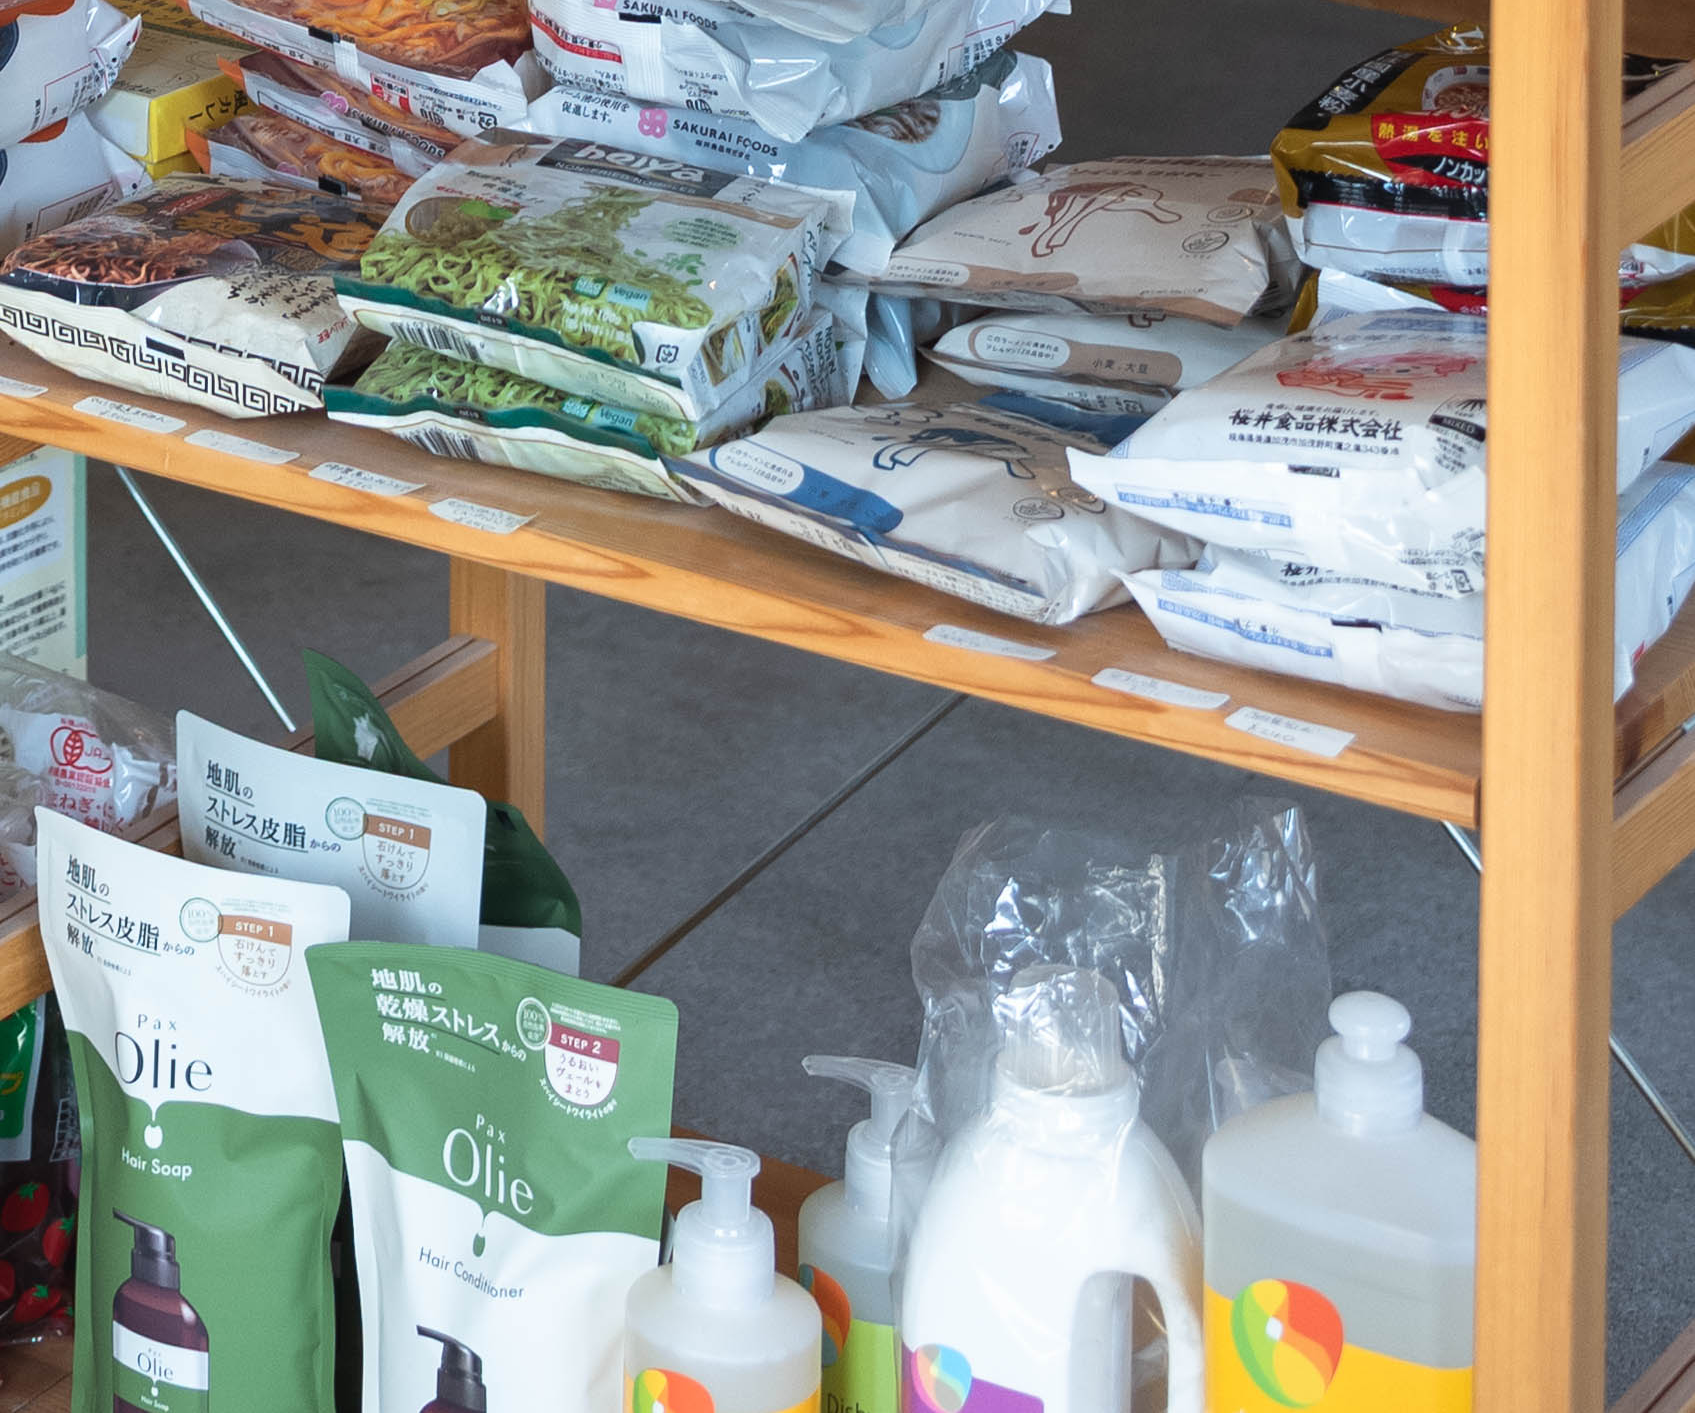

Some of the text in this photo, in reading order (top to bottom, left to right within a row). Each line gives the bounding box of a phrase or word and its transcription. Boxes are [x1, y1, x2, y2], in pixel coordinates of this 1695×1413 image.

[623, 0, 719, 31] SAKURAI FOODS
[561, 100, 613, 124] 促進します。
[672, 118, 779, 158] SAKURAI FOODS
[1432, 156, 1490, 185] ノンカッ
[612, 285, 650, 303] Vegan
[599, 407, 634, 428] Vegan
[1228, 407, 1404, 442] 桜井食品株式会社
[206, 759, 254, 801] 地肌の
[205, 795, 342, 853] ストレス皮脂からの
[377, 821, 415, 841] STEP 1
[66, 854, 111, 897] 地肌の
[375, 853, 415, 872] すっきり
[66, 892, 196, 956] ストレス皮脂からの
[234, 920, 274, 938] STEP 1
[234, 951, 276, 970] すっきり
[370, 968, 443, 995] 地肌の
[136, 1012, 178, 1032] Pax
[375, 993, 528, 1063] 乾燥ストレスからの
[560, 1033, 602, 1055] STEP 2
[114, 1029, 214, 1092] Olie
[559, 1053, 600, 1073] うるおい
[564, 1082, 590, 1100] まとう
[474, 1112, 507, 1144] Pax
[121, 1145, 193, 1182] Hair Soap
[442, 1127, 535, 1216] Olie
[418, 1245, 525, 1300] Hair Conditioner
[135, 1351, 175, 1381] Olie
